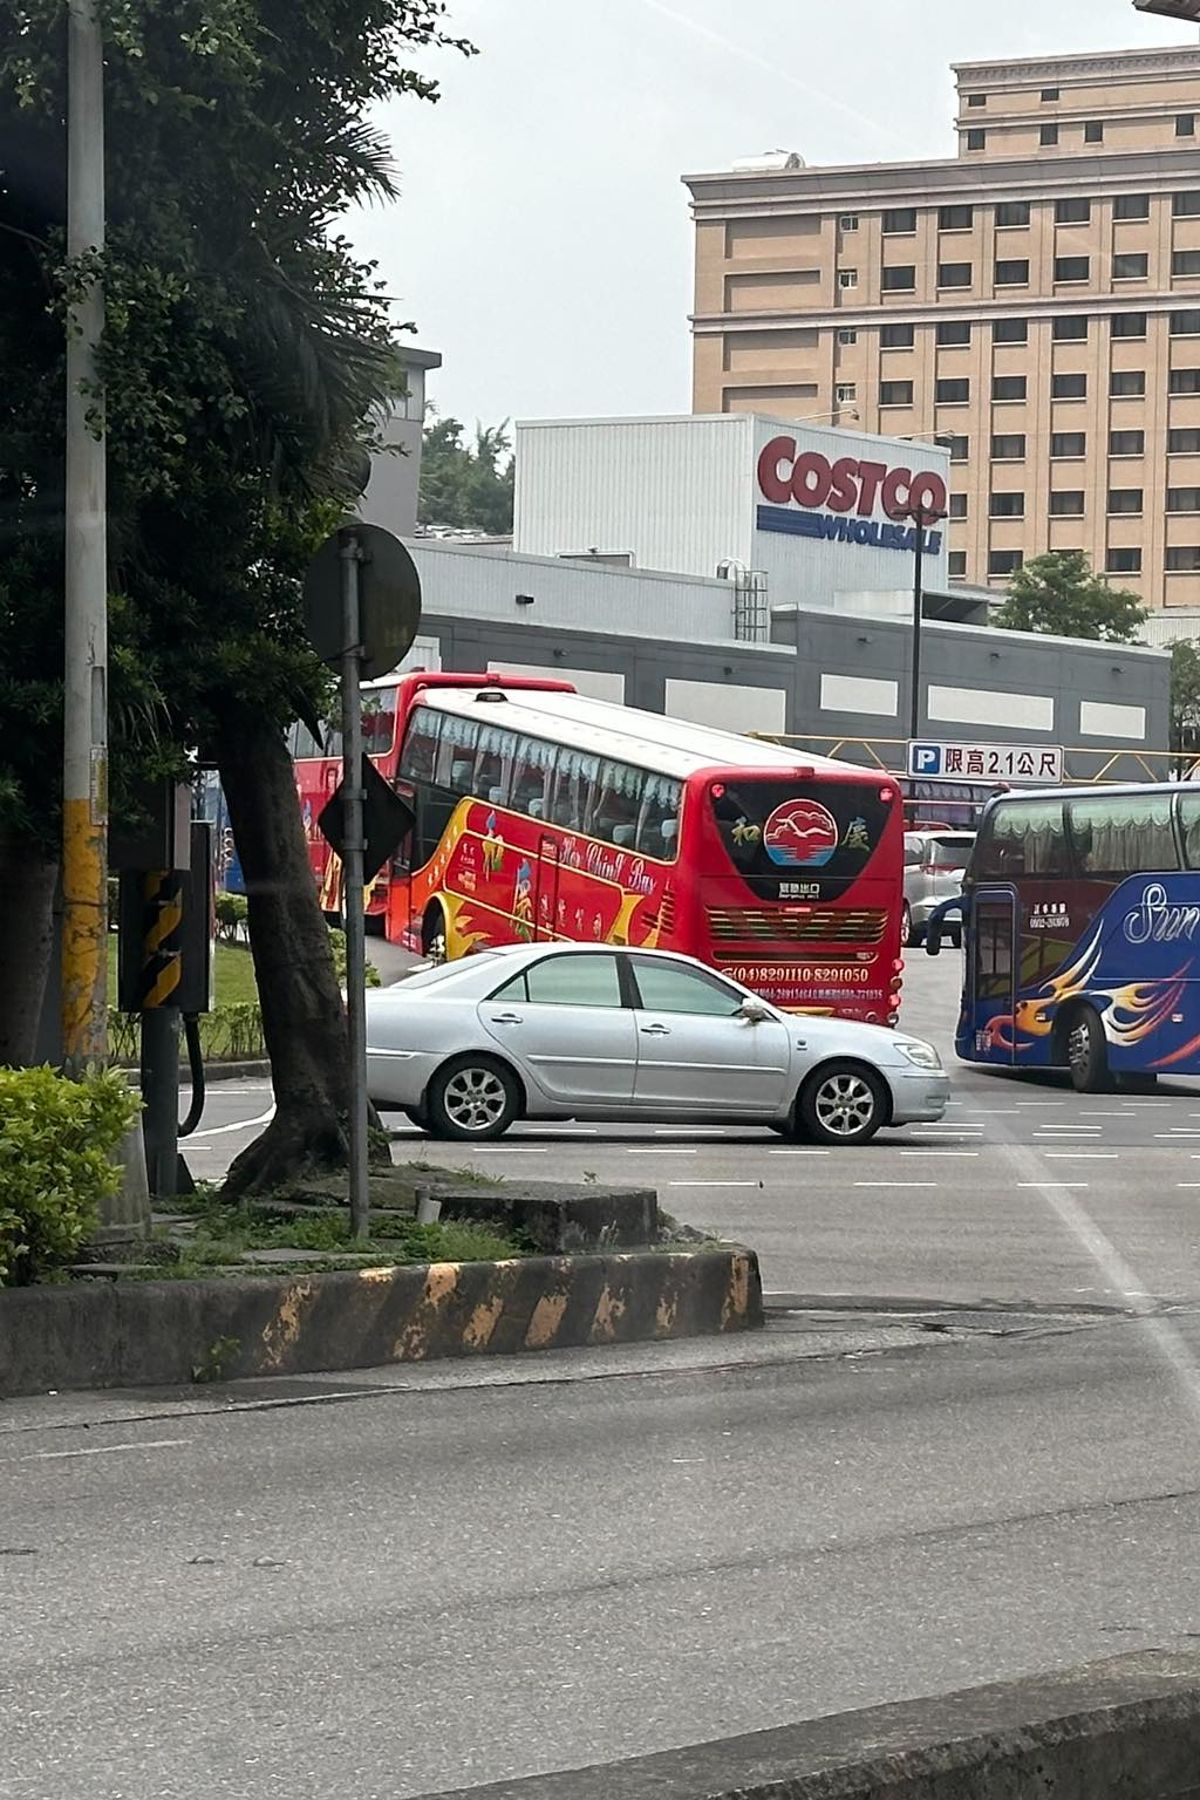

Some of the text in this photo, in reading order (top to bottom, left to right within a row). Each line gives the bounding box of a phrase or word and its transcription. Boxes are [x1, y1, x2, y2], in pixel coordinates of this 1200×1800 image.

[757, 435, 946, 526] COSTCO
[945, 748, 1056, 776] 限高2.1公尺
[1123, 883, 1200, 943] Sun
